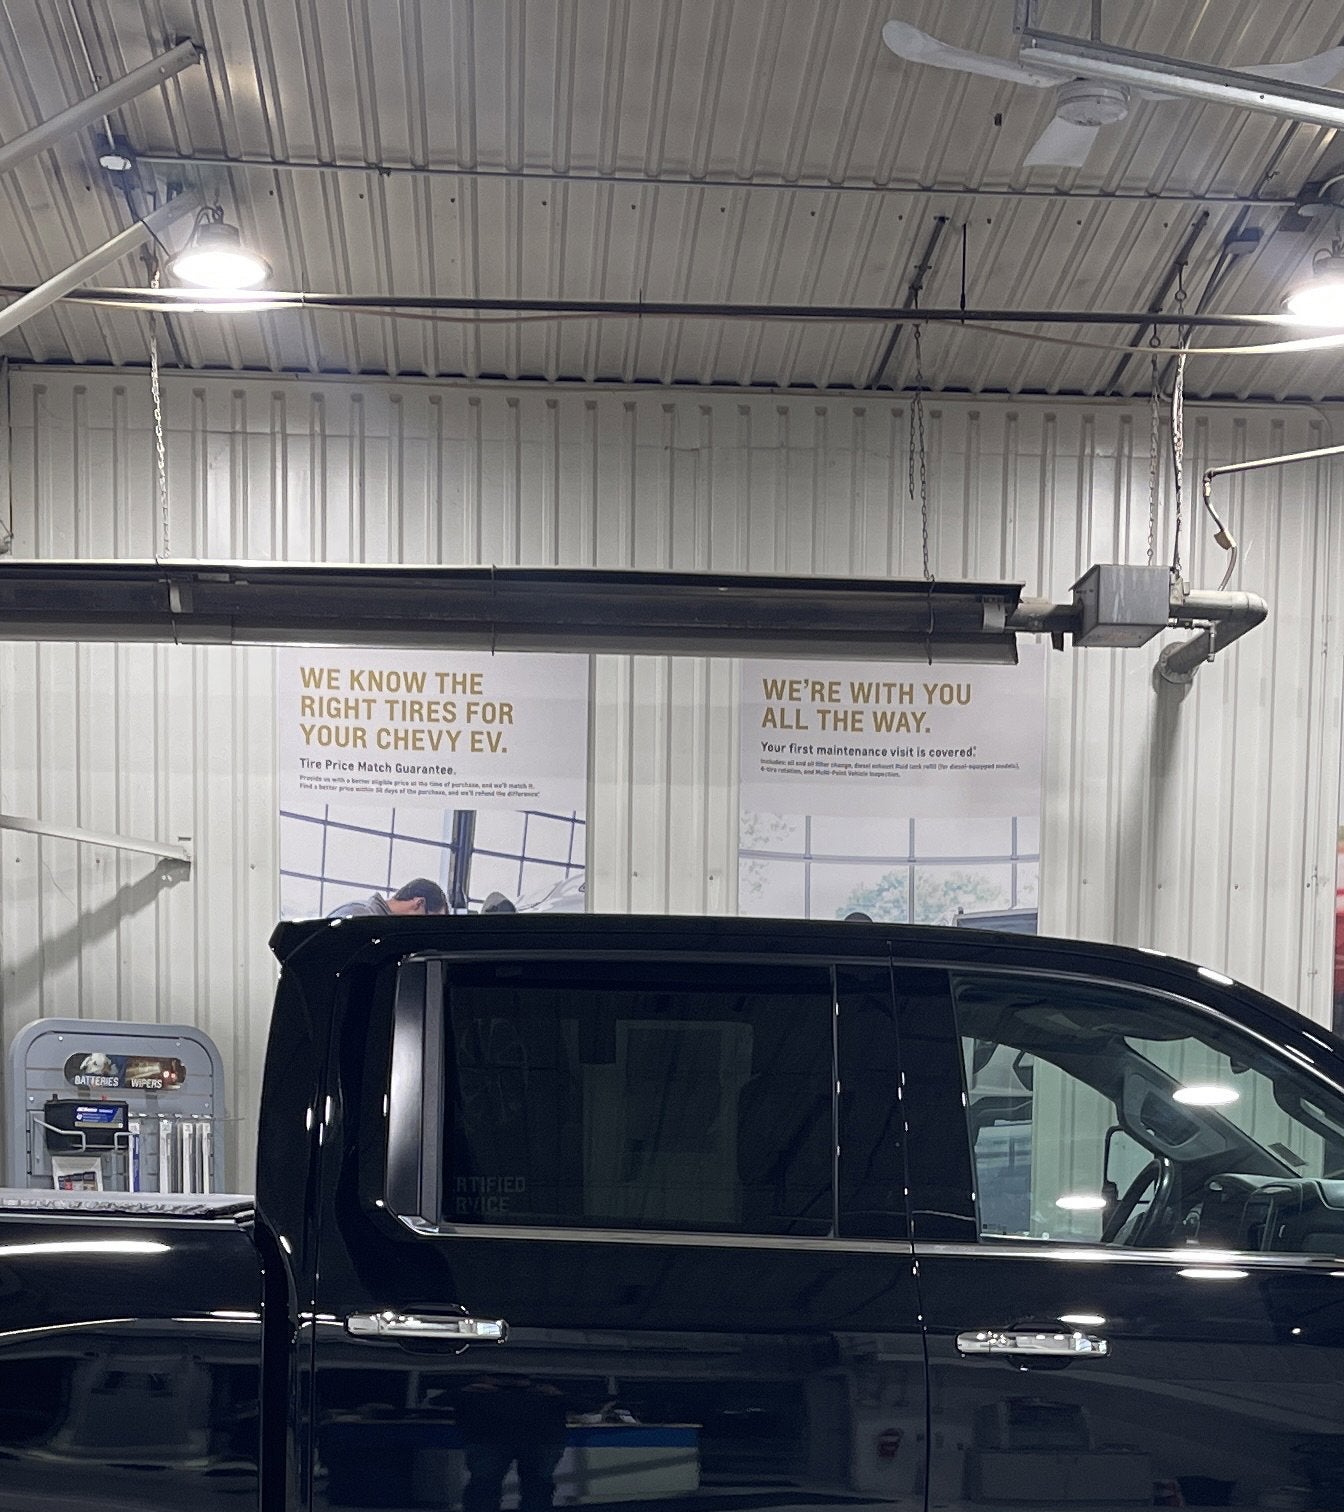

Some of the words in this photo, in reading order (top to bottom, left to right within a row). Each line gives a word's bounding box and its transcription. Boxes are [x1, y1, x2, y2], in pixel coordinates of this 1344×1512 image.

[300, 667, 341, 690] WE
[350, 669, 427, 693] KNOW
[435, 672, 484, 695] THE
[763, 678, 841, 703] WE'RE
[849, 682, 914, 705] WITH
[923, 683, 971, 705] YOU
[300, 695, 377, 720] RIGHT
[385, 699, 457, 723] TIRES
[467, 702, 514, 725] FOR
[762, 707, 809, 730] ALL
[817, 709, 865, 732] THE
[872, 711, 931, 733] WAY.
[300, 724, 367, 749] YOUR
[376, 728, 462, 751] CHEVY
[470, 731, 508, 753] EV.
[761, 741, 787, 753] Your
[789, 743, 814, 755] first
[817, 744, 887, 756] maintenance
[890, 745, 914, 757] visit
[917, 746, 926, 757] is
[300, 758, 322, 770] Tire
[325, 759, 354, 771] Price
[357, 761, 392, 774] Match
[395, 763, 457, 775] Guarantee.
[75, 1075, 119, 1087] BATTERIES
[131, 1078, 163, 1089] WIPERS
